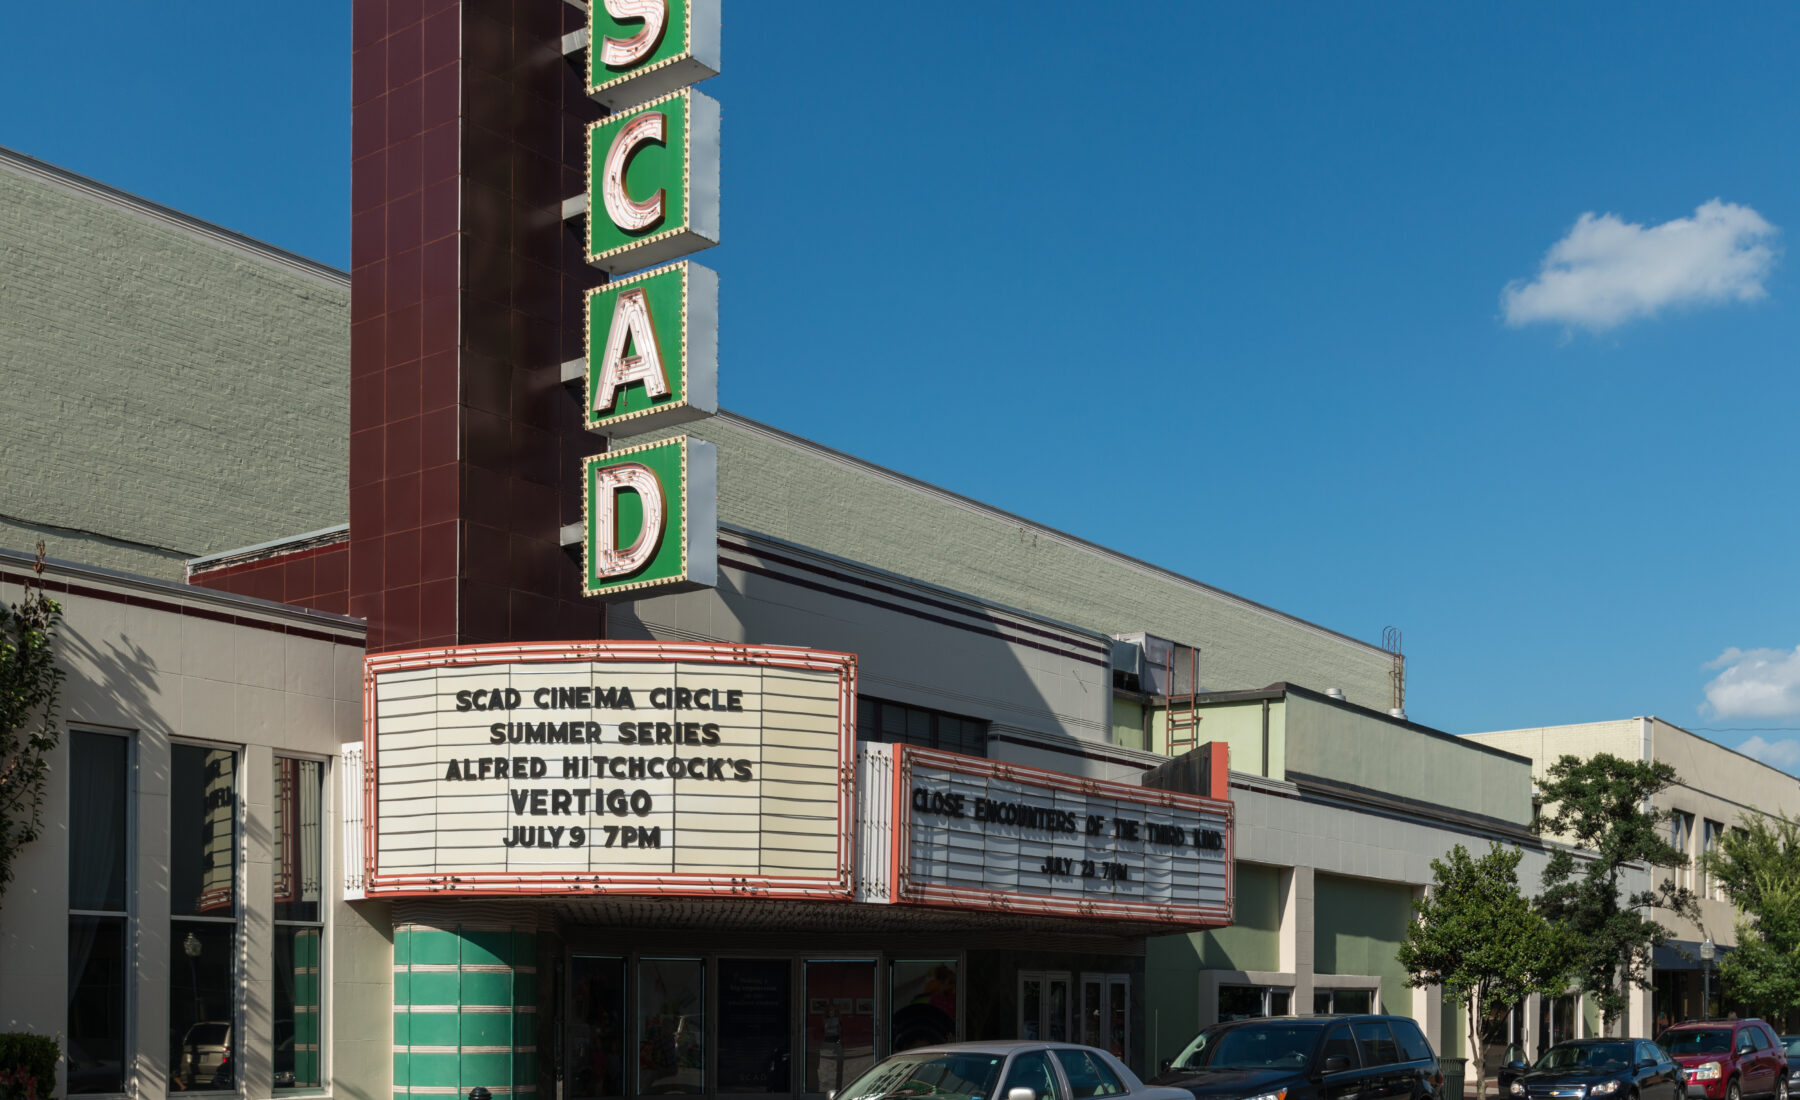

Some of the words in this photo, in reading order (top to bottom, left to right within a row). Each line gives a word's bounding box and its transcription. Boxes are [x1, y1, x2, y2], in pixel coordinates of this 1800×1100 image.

[456, 687, 522, 712] SCAD
[533, 687, 636, 710] CINEMA
[649, 687, 744, 712] CIRCLE
[489, 721, 602, 745] SUMMER
[617, 722, 721, 746] SERIES
[445, 756, 548, 781] ALFRED
[562, 756, 753, 782] HITCHCOCK'S
[510, 788, 653, 816] VERTIGO
[912, 788, 965, 819] CLOSE
[975, 797, 1076, 834] ENCOUNTERS
[1086, 815, 1105, 836] OF
[503, 826, 564, 849] JULY
[568, 826, 586, 848] 9
[603, 825, 661, 849] 7PM
[1040, 856, 1073, 876] JULY
